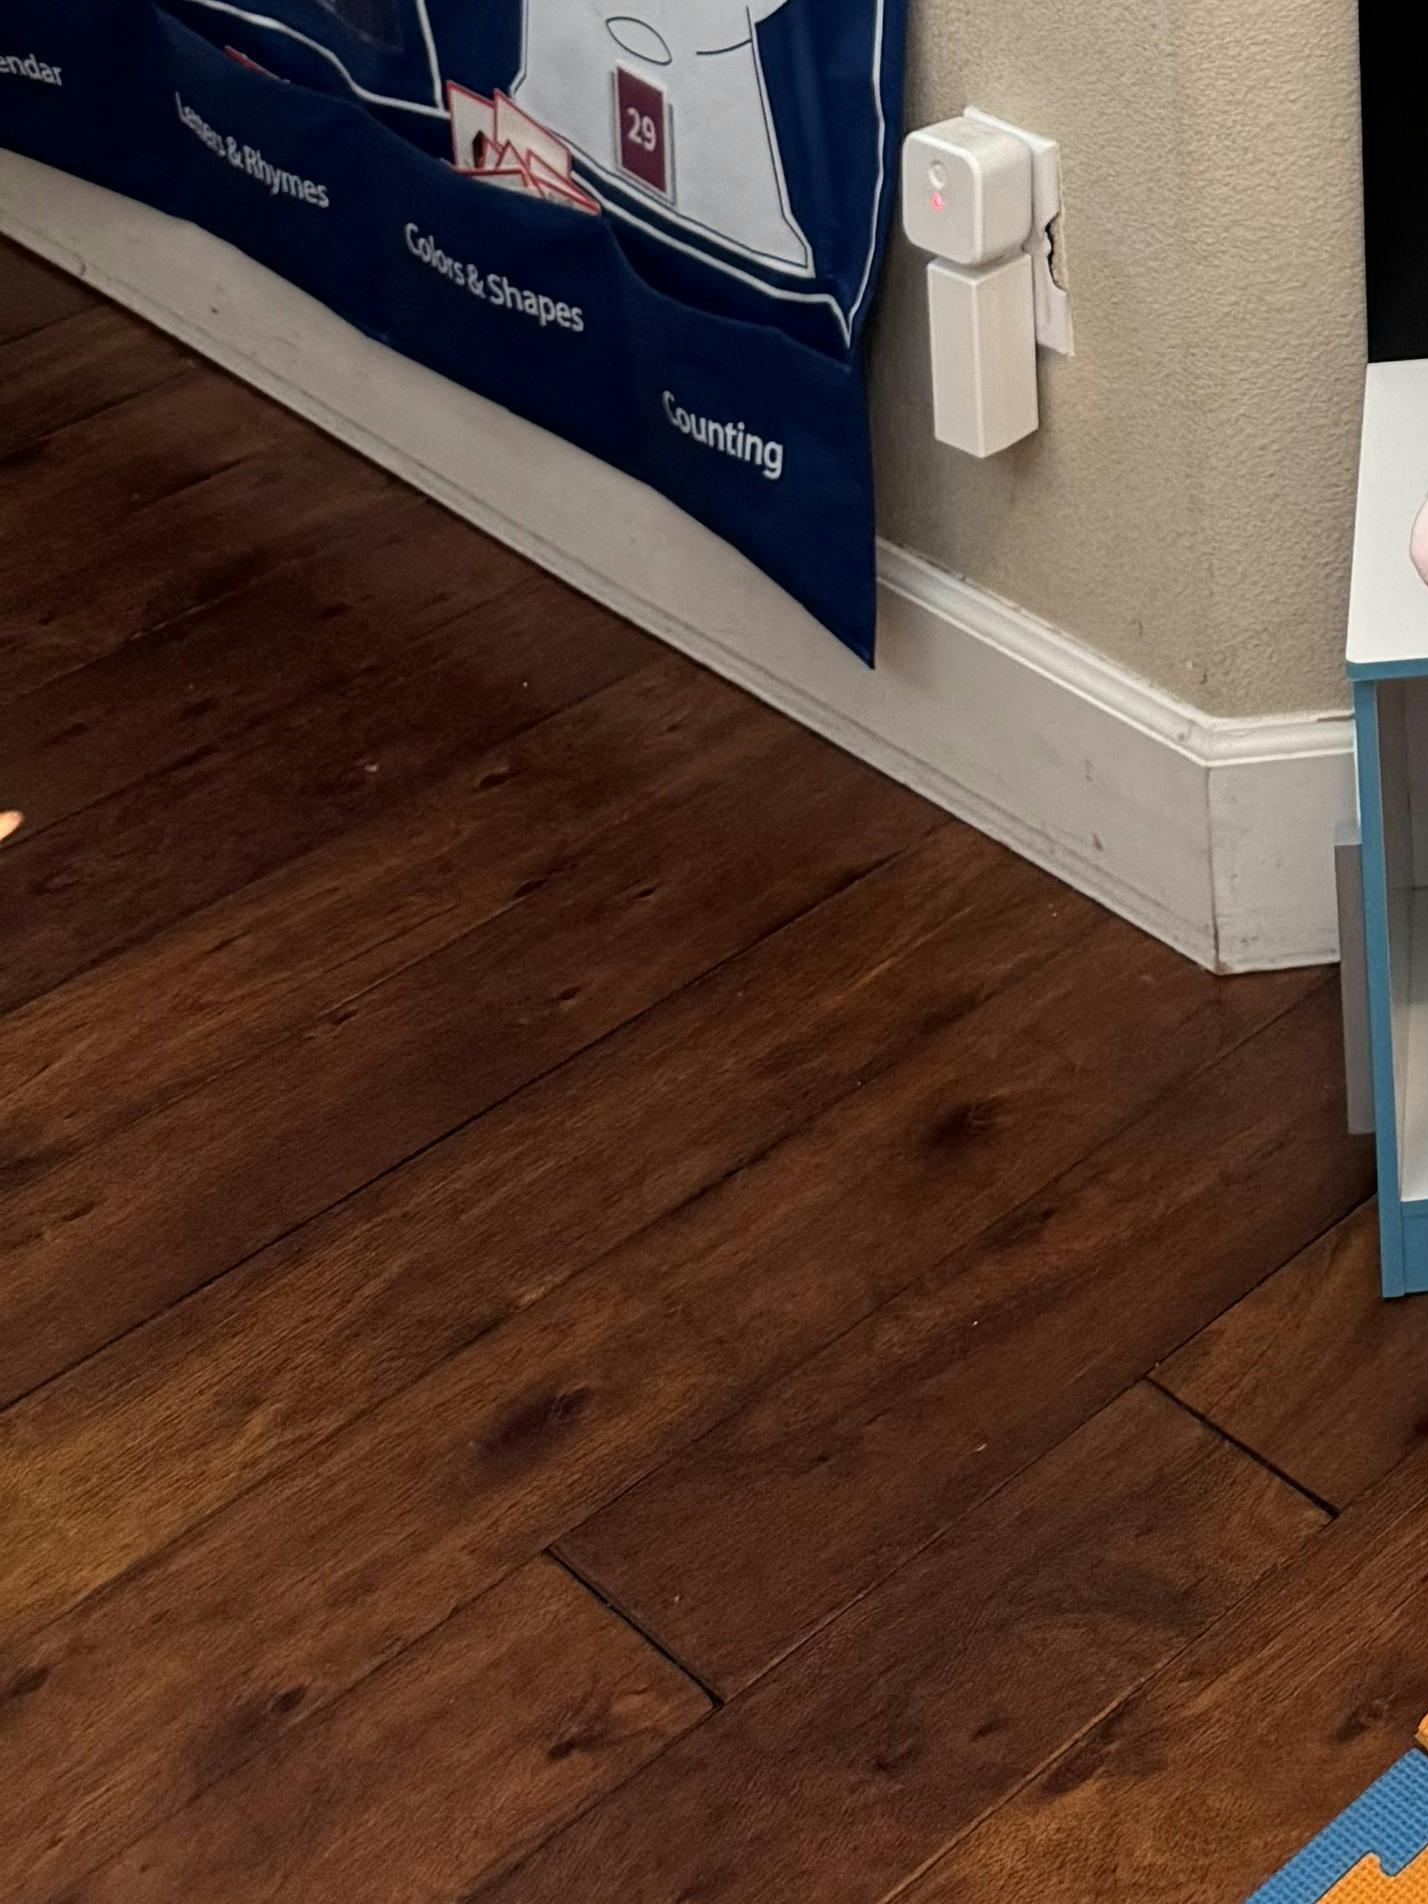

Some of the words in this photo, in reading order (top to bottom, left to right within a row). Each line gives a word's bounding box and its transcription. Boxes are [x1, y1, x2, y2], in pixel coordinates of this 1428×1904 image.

[626, 106, 657, 152] 29
[225, 135, 245, 169] &
[242, 144, 330, 209] Rhymes
[404, 221, 466, 287] Colors
[465, 262, 487, 299] &
[487, 272, 586, 333] Shapes
[662, 389, 785, 481] Counting
